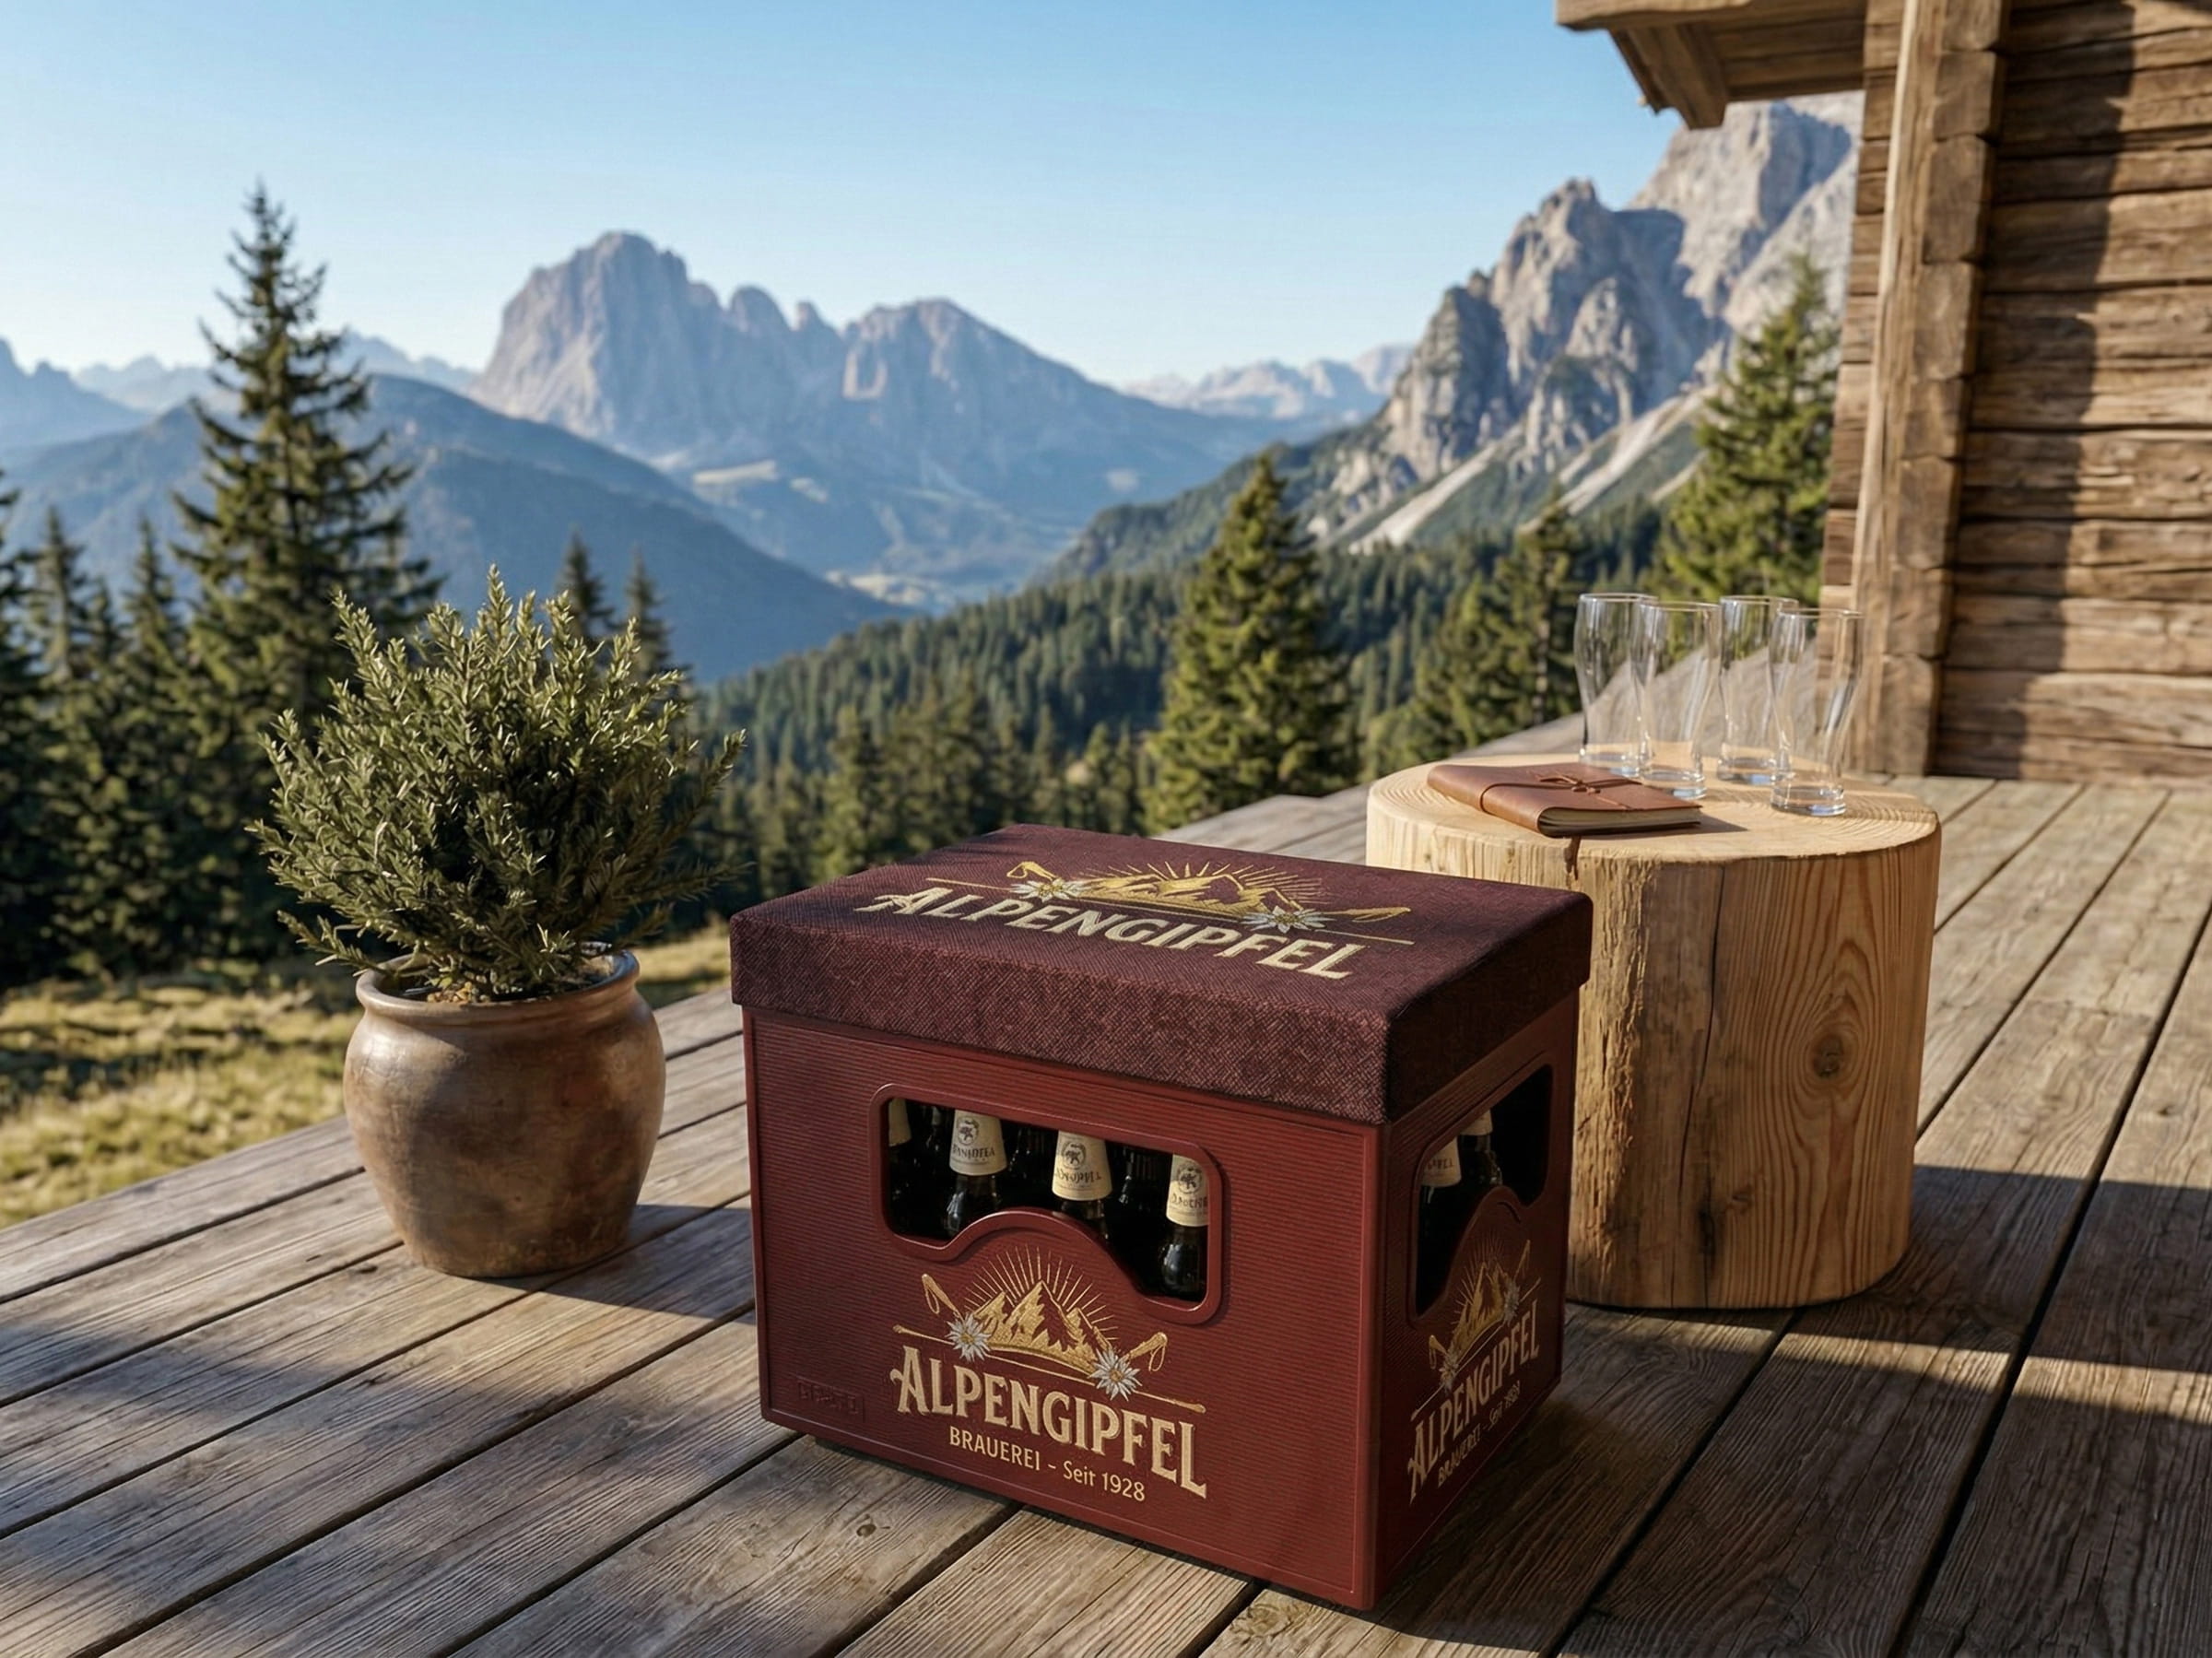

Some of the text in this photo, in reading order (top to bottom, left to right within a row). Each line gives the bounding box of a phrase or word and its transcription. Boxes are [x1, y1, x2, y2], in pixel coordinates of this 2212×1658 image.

[853, 887, 1371, 980] ALPENGIPFEL
[889, 1345, 1207, 1499] ALPENGIPFEL
[1407, 1298, 1540, 1505] ALPENGIPFEL
[949, 1426, 1041, 1471] BRAUEREI
[1063, 1460, 1096, 1487] Seit
[1102, 1472, 1146, 1502] 1928
